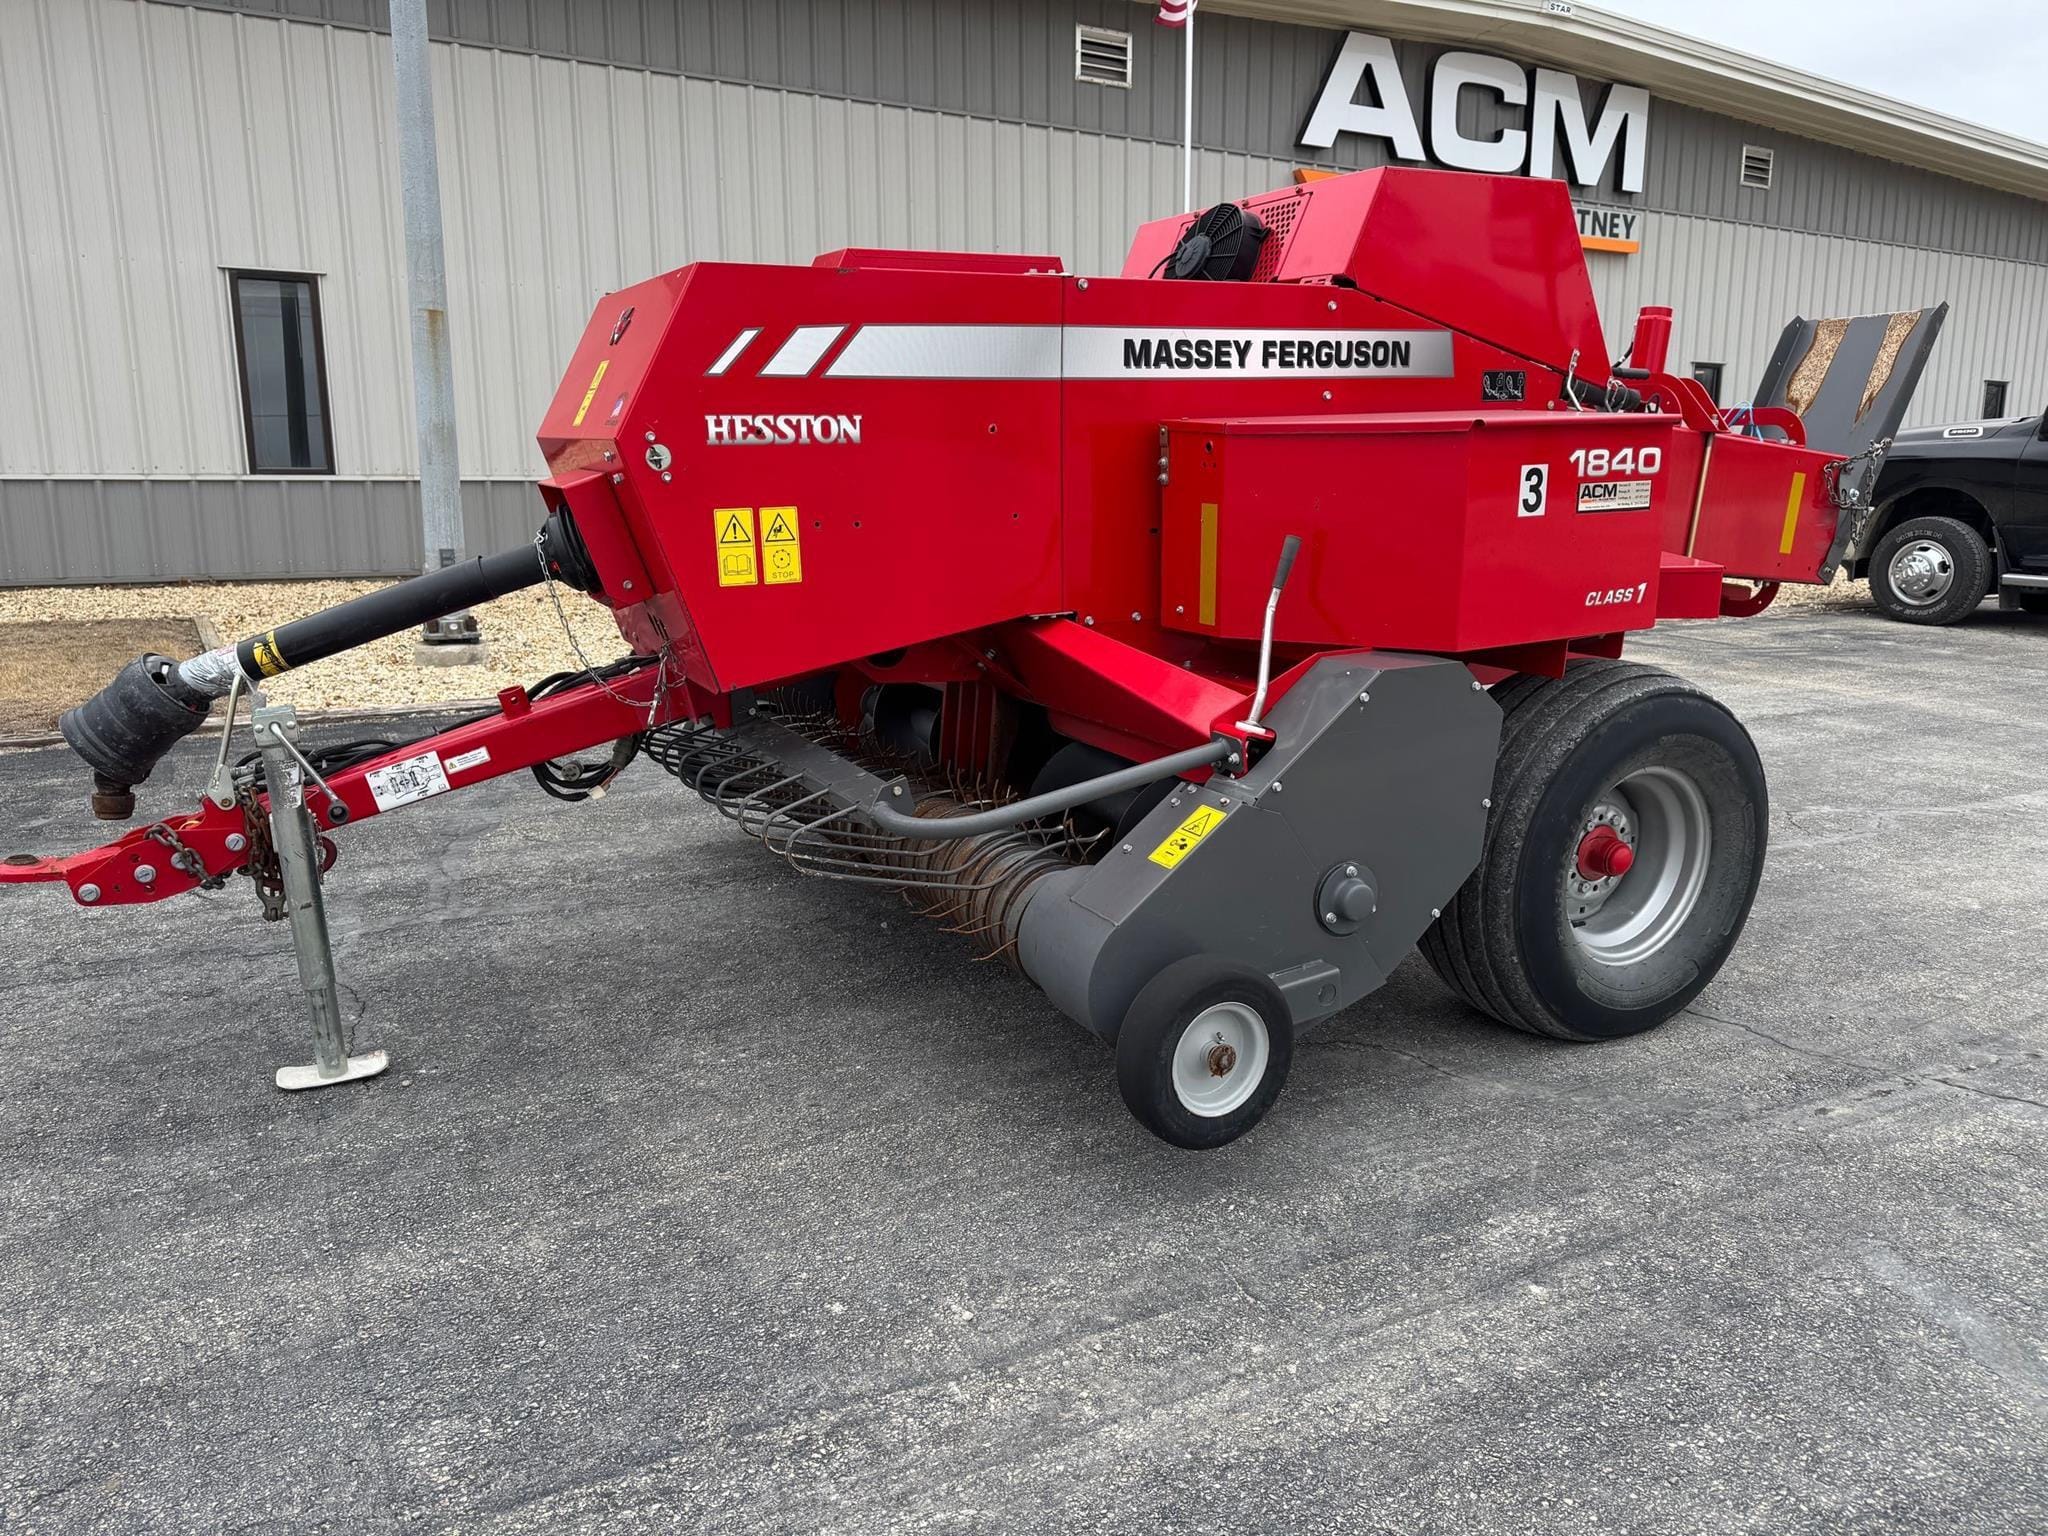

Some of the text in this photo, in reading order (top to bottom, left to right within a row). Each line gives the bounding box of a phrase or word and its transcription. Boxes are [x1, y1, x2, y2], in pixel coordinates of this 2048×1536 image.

[1550, 3, 1571, 13] STAR
[1299, 31, 1650, 193] ACM
[1573, 208, 1636, 239] TNEY
[1123, 338, 1410, 369] MASSEY FERGUSON
[704, 414, 863, 446] HESSTON
[1569, 447, 1662, 477] 1840
[1522, 467, 1544, 513] 3
[1580, 484, 1618, 499] ACM
[771, 571, 795, 579] STOP
[1585, 582, 1648, 607] CLASS 1
